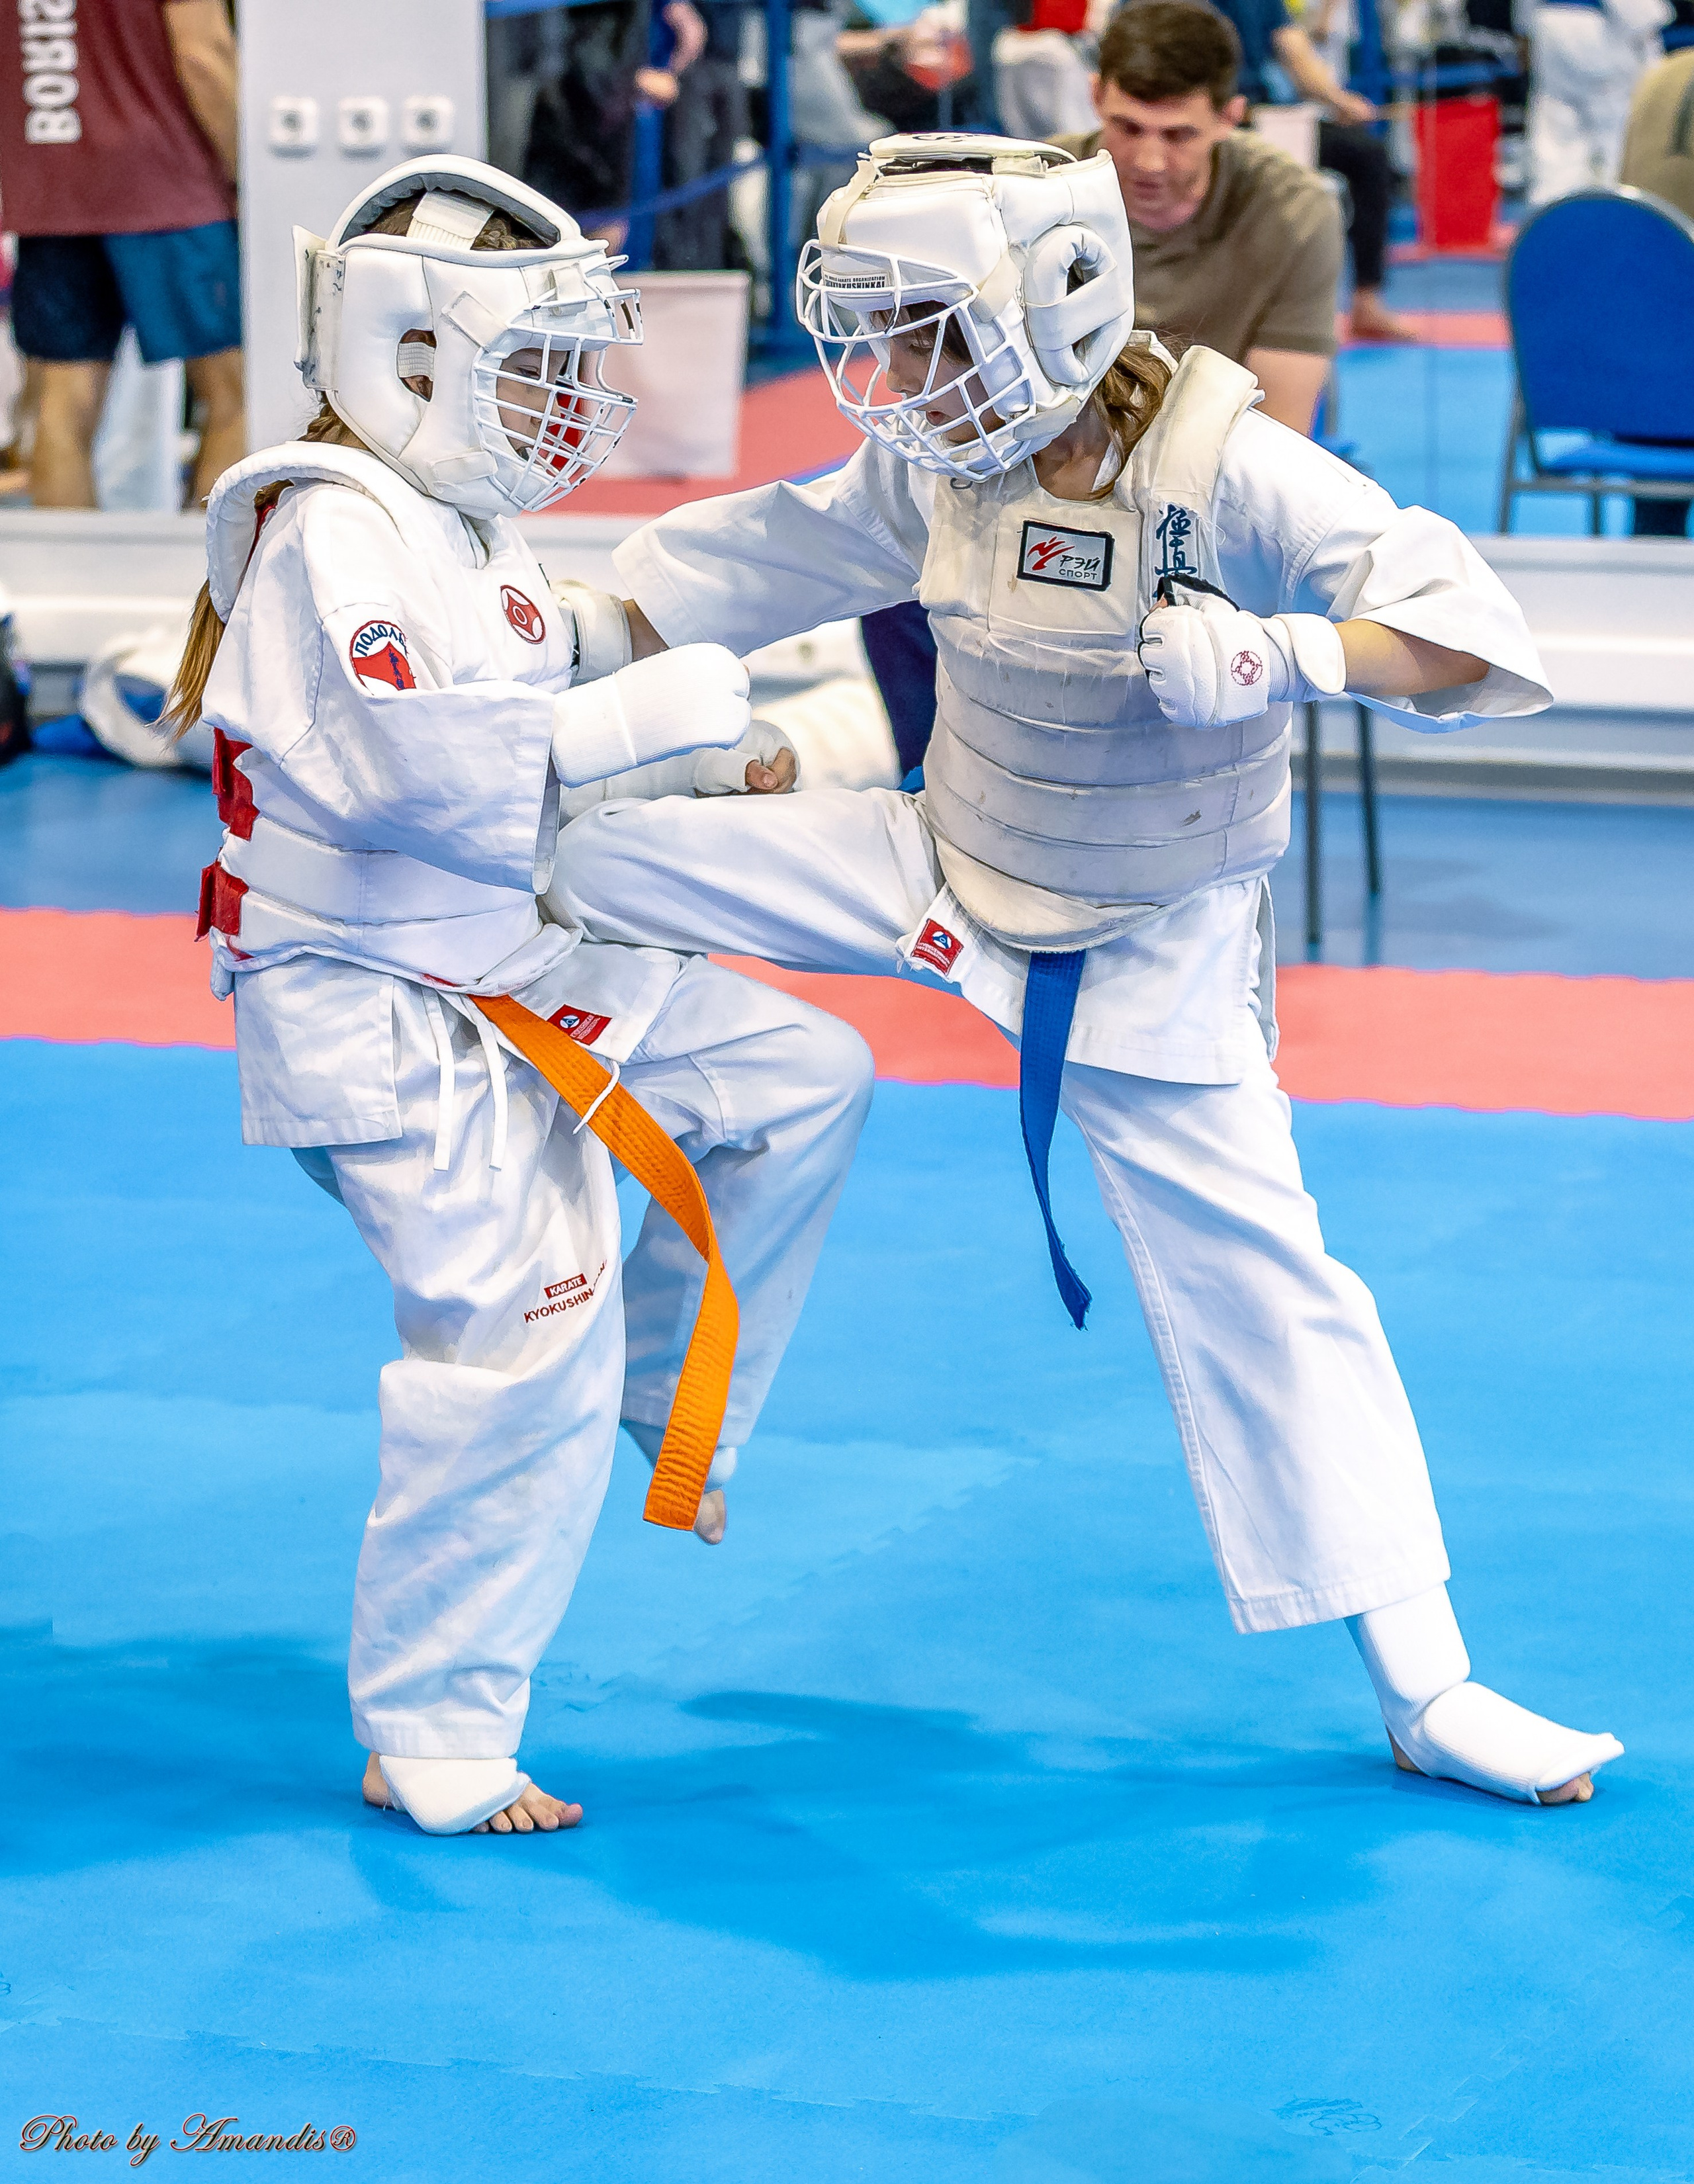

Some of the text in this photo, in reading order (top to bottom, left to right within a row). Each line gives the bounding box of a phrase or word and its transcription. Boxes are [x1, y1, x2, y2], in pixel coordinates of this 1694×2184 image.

[1059, 555, 1100, 571] РЭЙ
[1059, 569, 1097, 580] СПОРТ
[549, 1277, 583, 1296] KARATE
